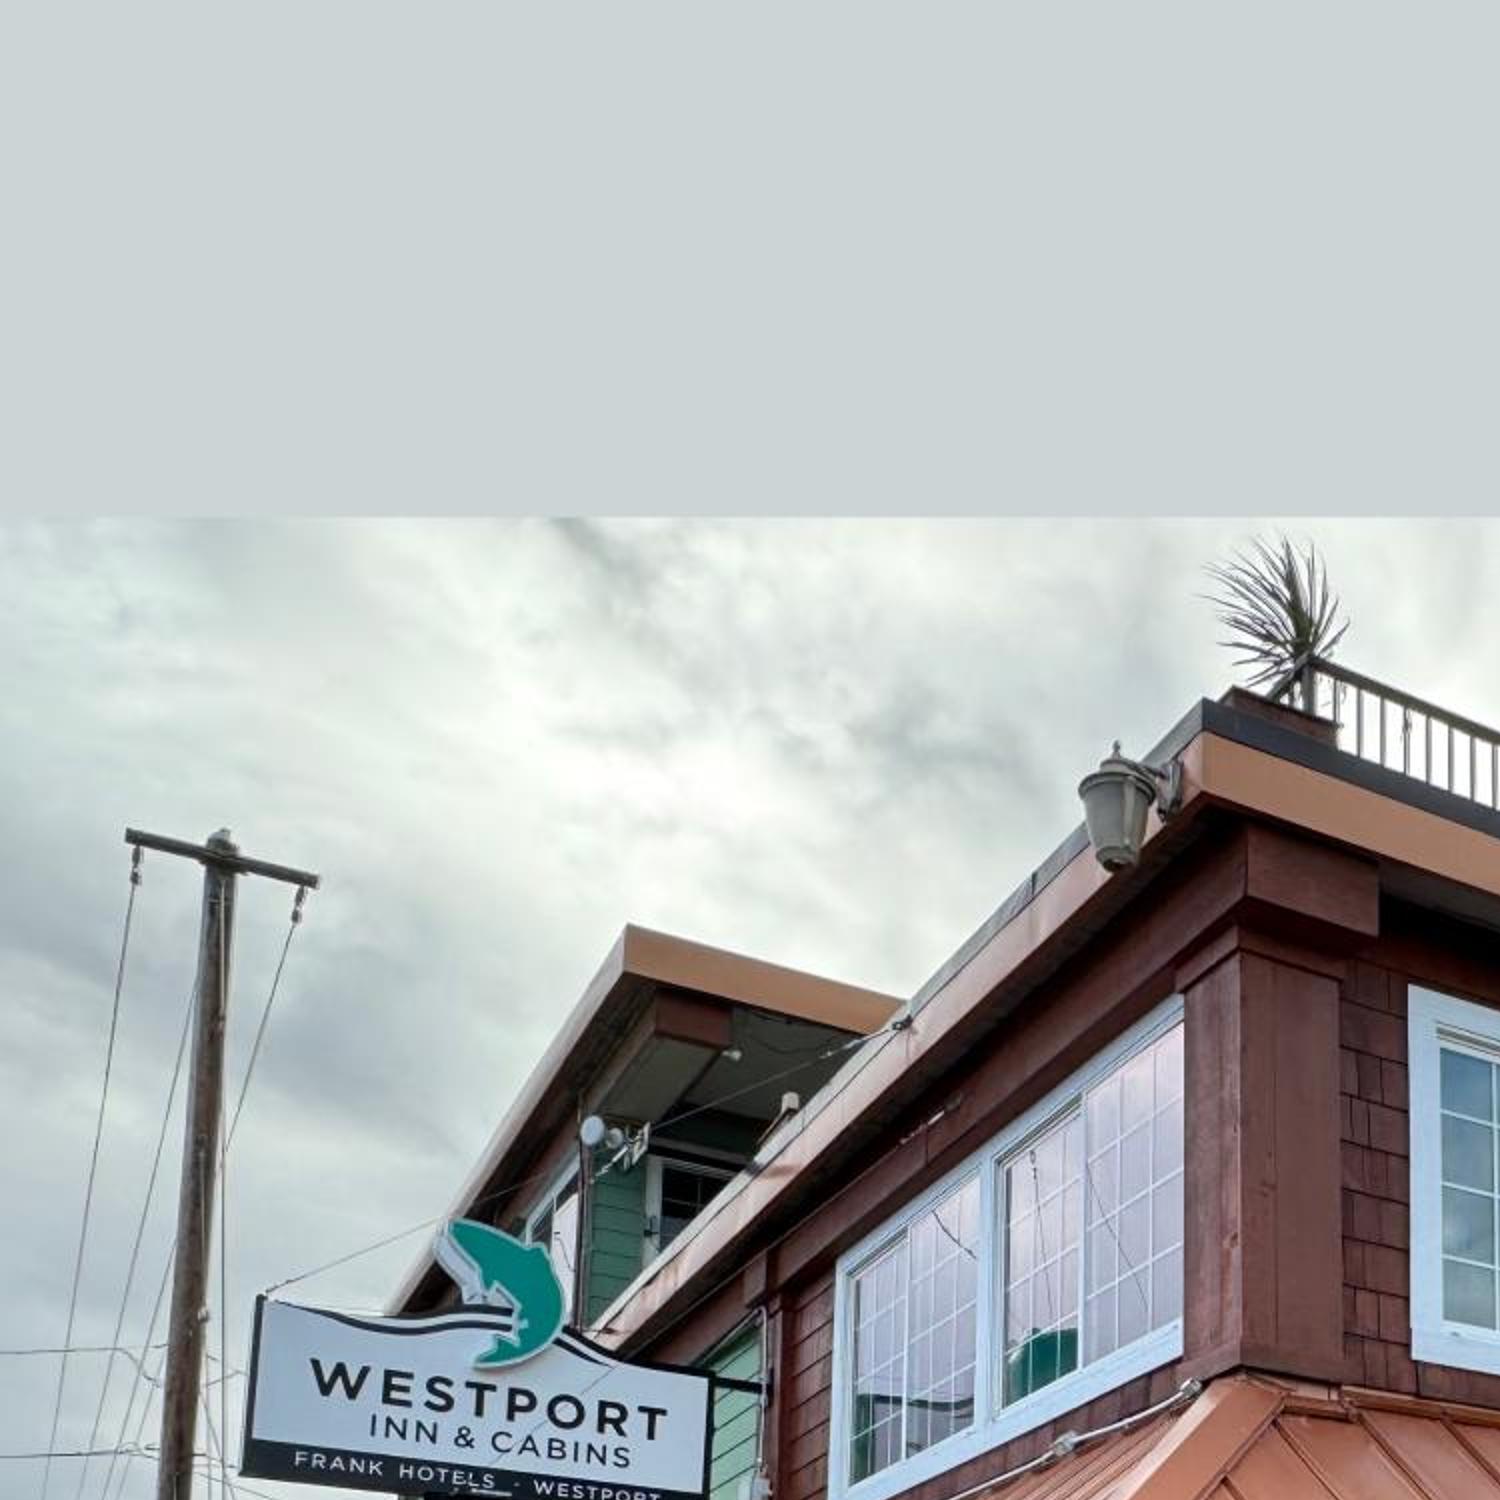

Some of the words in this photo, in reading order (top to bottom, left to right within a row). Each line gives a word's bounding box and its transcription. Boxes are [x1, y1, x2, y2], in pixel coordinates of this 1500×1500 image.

[310, 1357, 668, 1441] WESTPORT
[370, 1414, 438, 1444] INN
[454, 1427, 475, 1449] &
[491, 1432, 630, 1468] CABINS
[294, 1451, 384, 1476] FRANK
[399, 1463, 495, 1489] HOTELS
